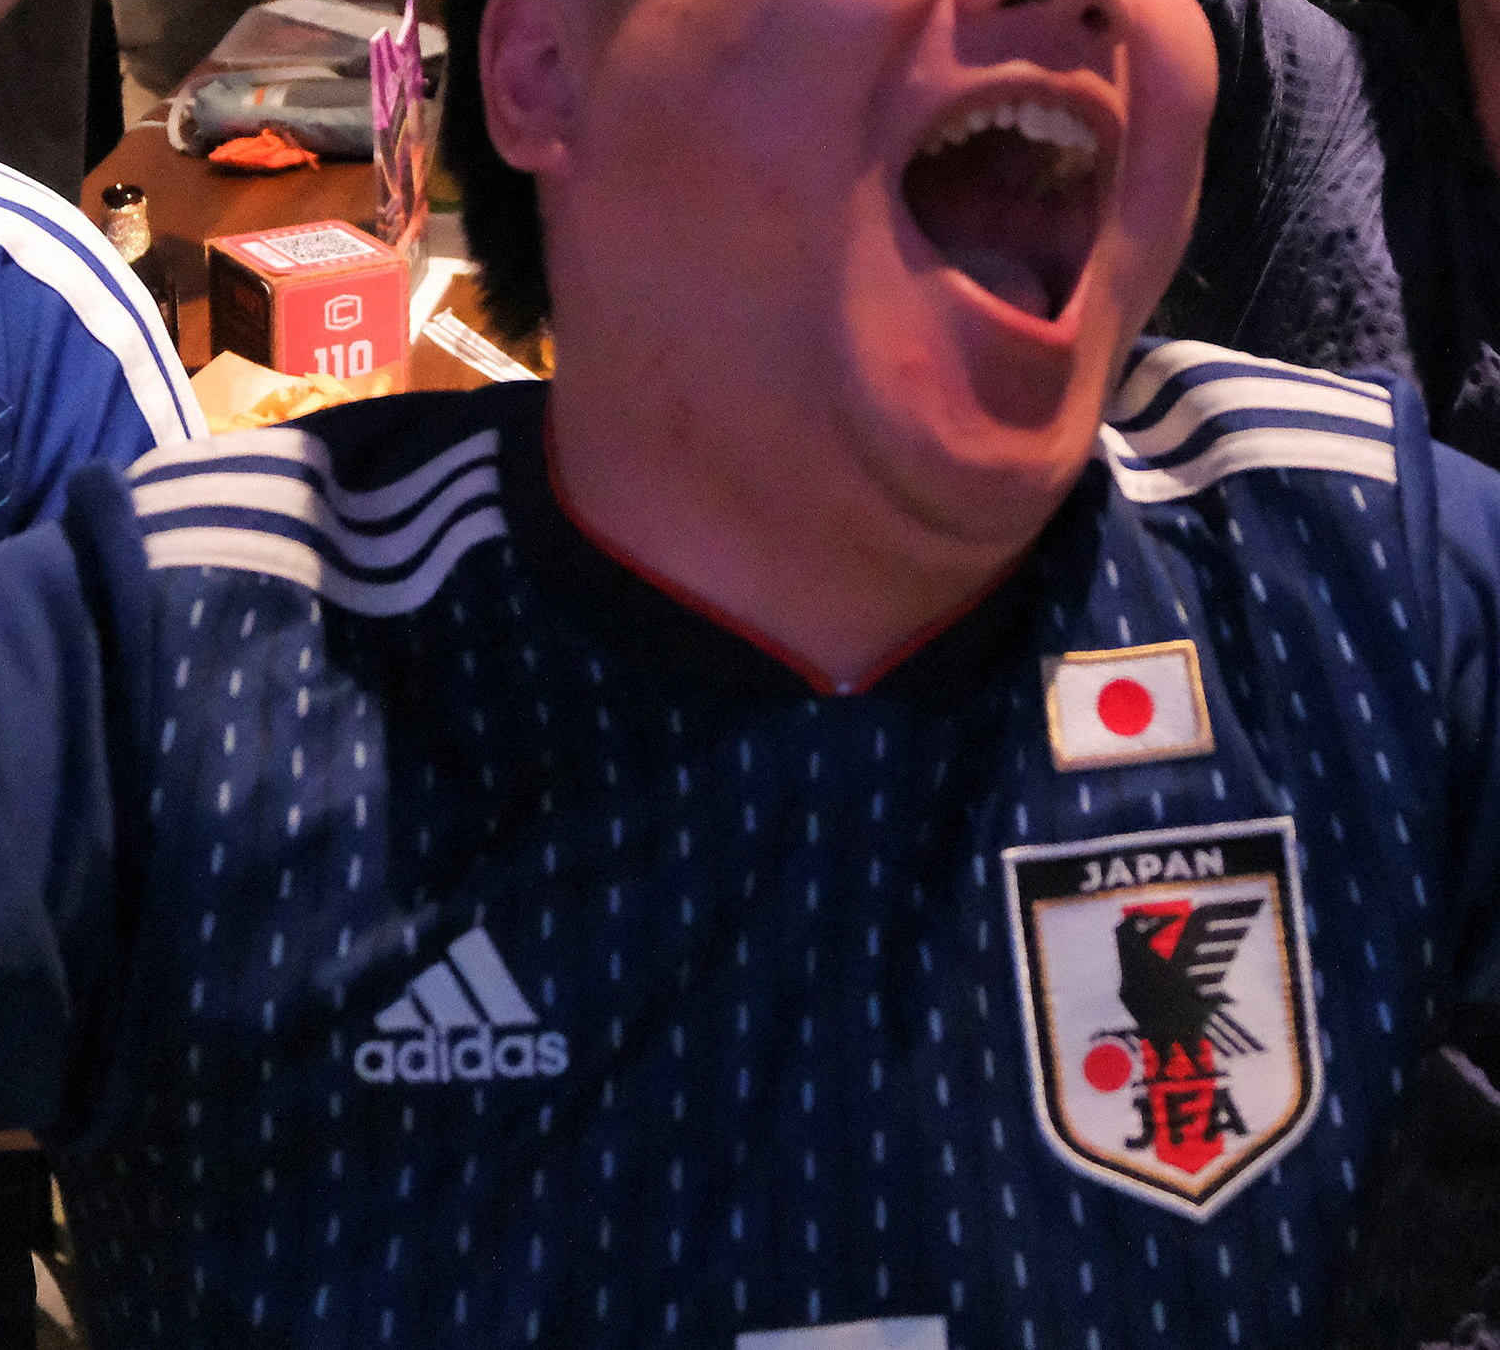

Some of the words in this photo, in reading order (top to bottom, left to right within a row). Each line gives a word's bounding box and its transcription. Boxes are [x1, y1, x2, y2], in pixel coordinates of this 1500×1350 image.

[1078, 847, 1225, 892] JAPAN
[353, 1024, 571, 1084] adidas
[1125, 1088, 1250, 1150] JFA
